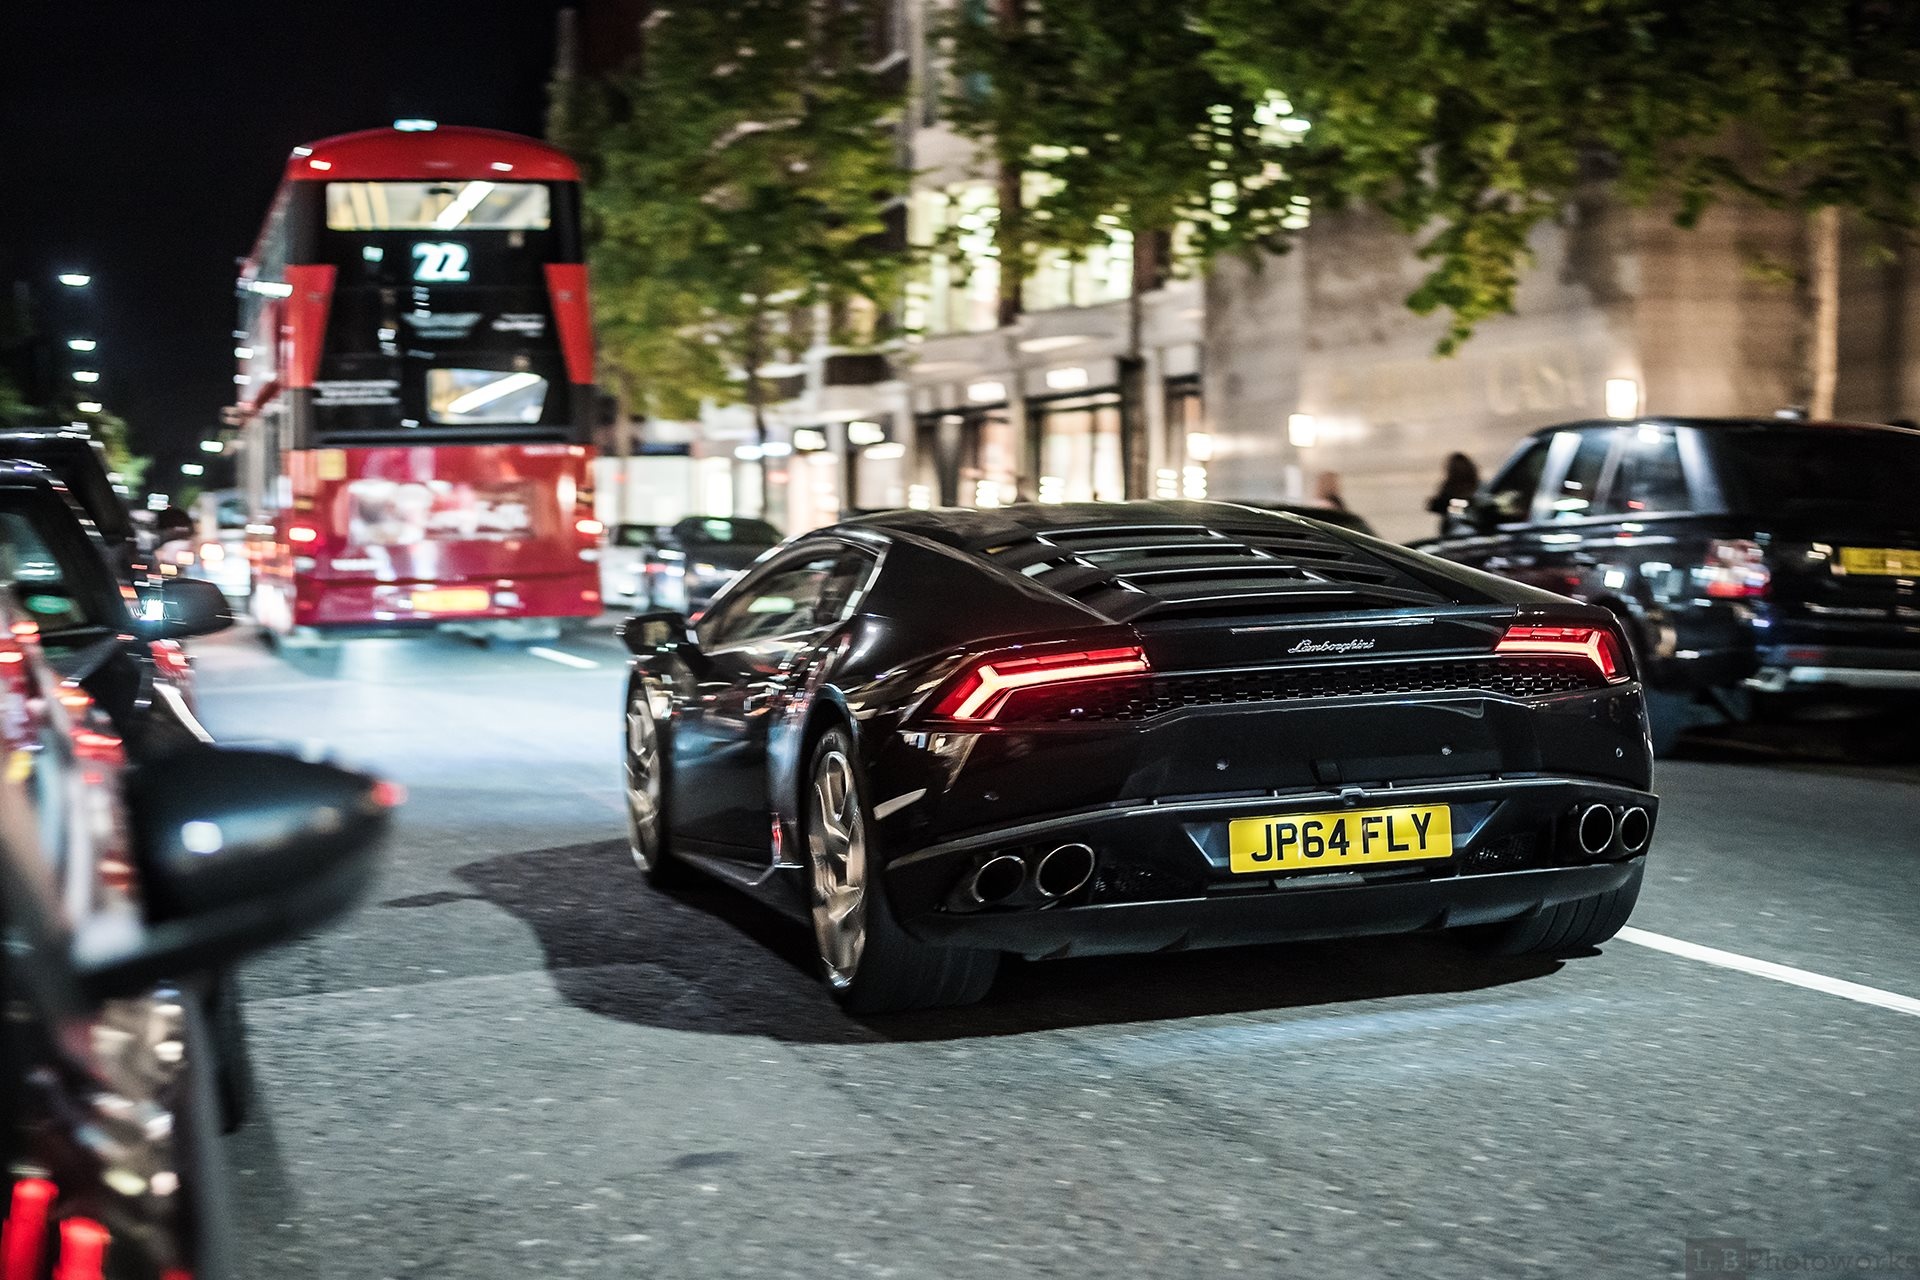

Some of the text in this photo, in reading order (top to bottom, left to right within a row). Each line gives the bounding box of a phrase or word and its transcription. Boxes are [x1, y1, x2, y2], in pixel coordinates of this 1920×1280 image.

[412, 242, 471, 282] 22
[1288, 638, 1376, 654] Lamborghini
[1251, 812, 1432, 862] JP64 FLY
